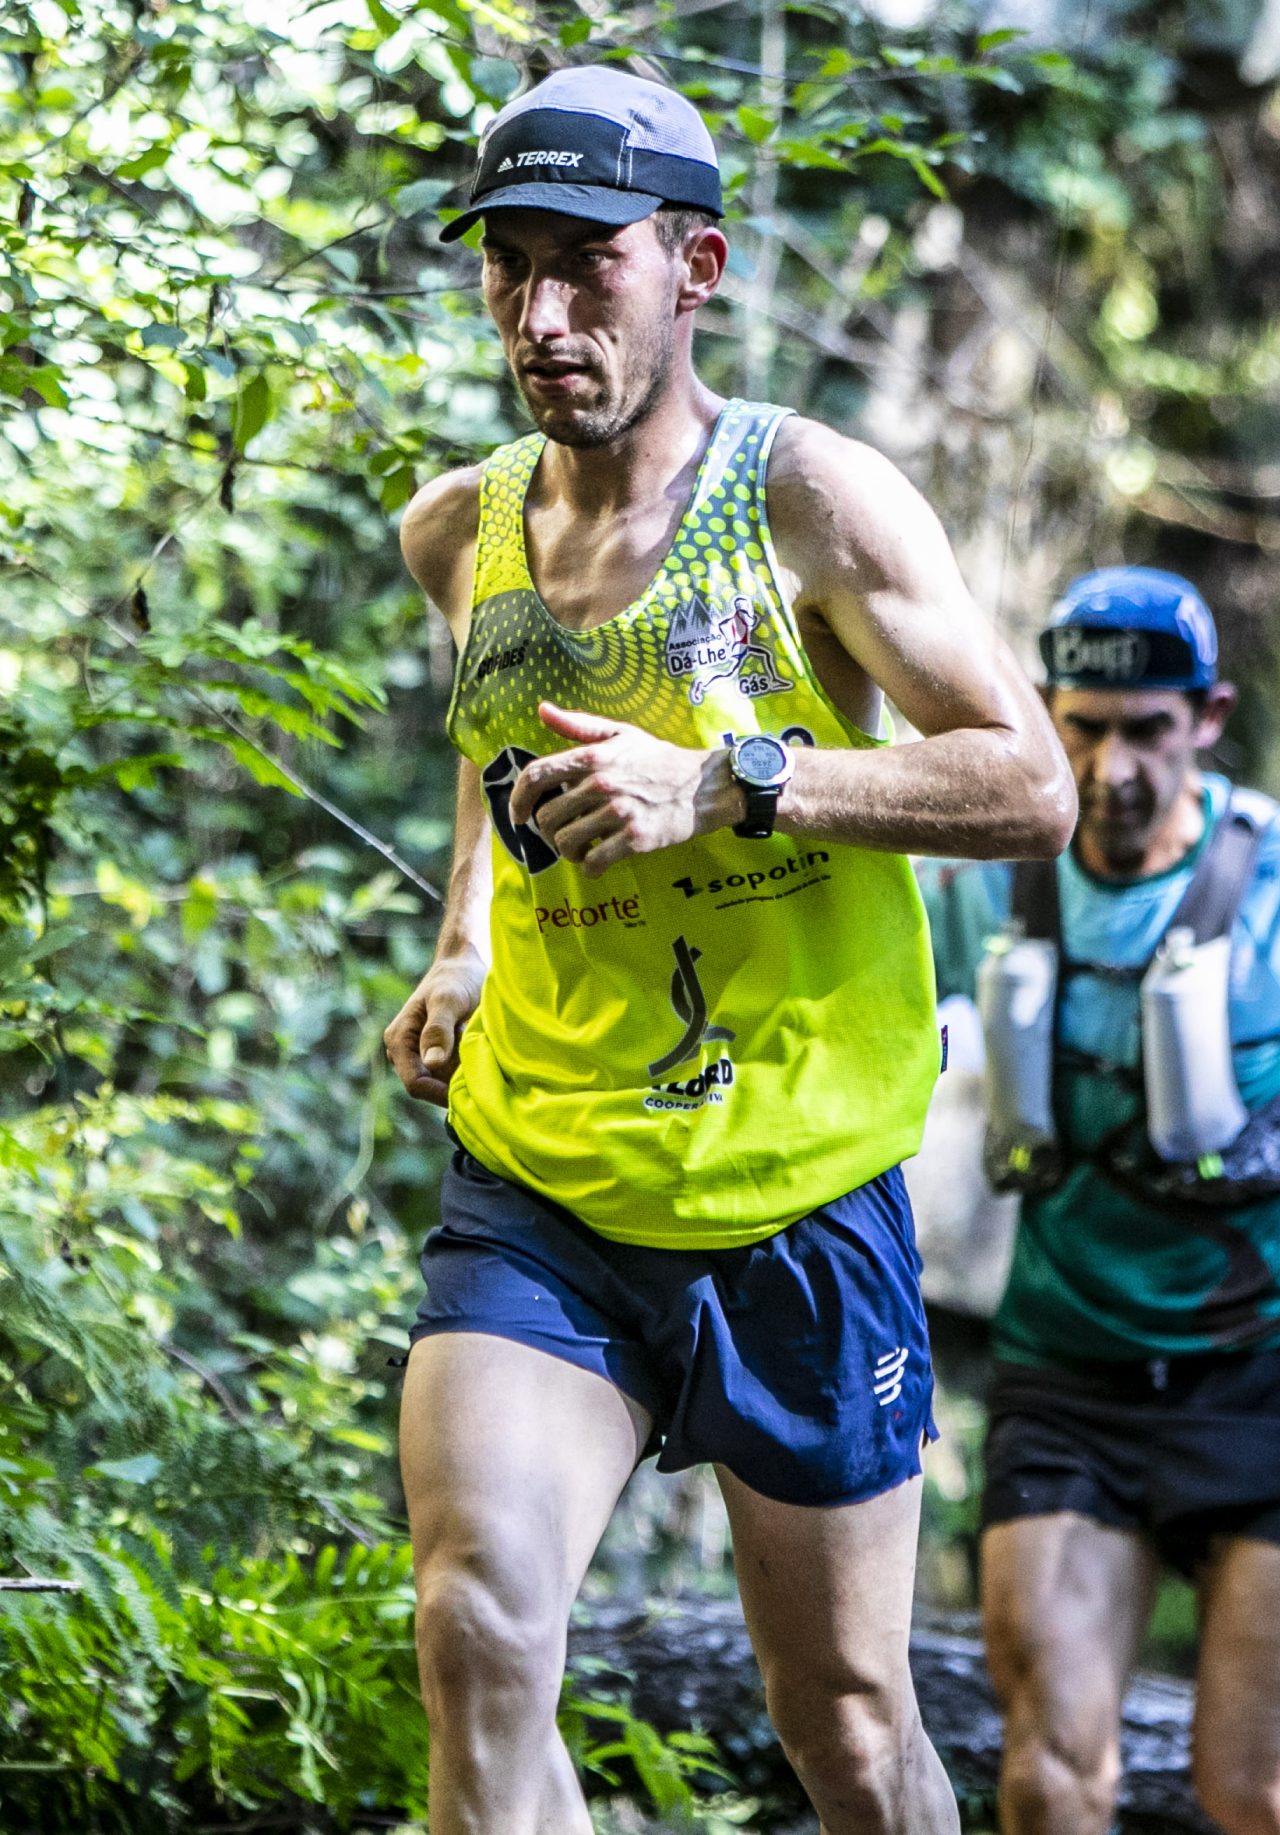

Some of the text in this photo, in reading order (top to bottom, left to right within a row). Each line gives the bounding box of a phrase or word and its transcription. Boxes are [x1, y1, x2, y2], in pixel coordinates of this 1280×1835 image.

[516, 150, 584, 168] TERREX
[668, 633, 722, 651] Associação
[670, 648, 727, 673] Dá-Lhe
[739, 675, 769, 694] Gás
[707, 850, 830, 894] sopotin
[535, 896, 640, 933] Pelcorte
